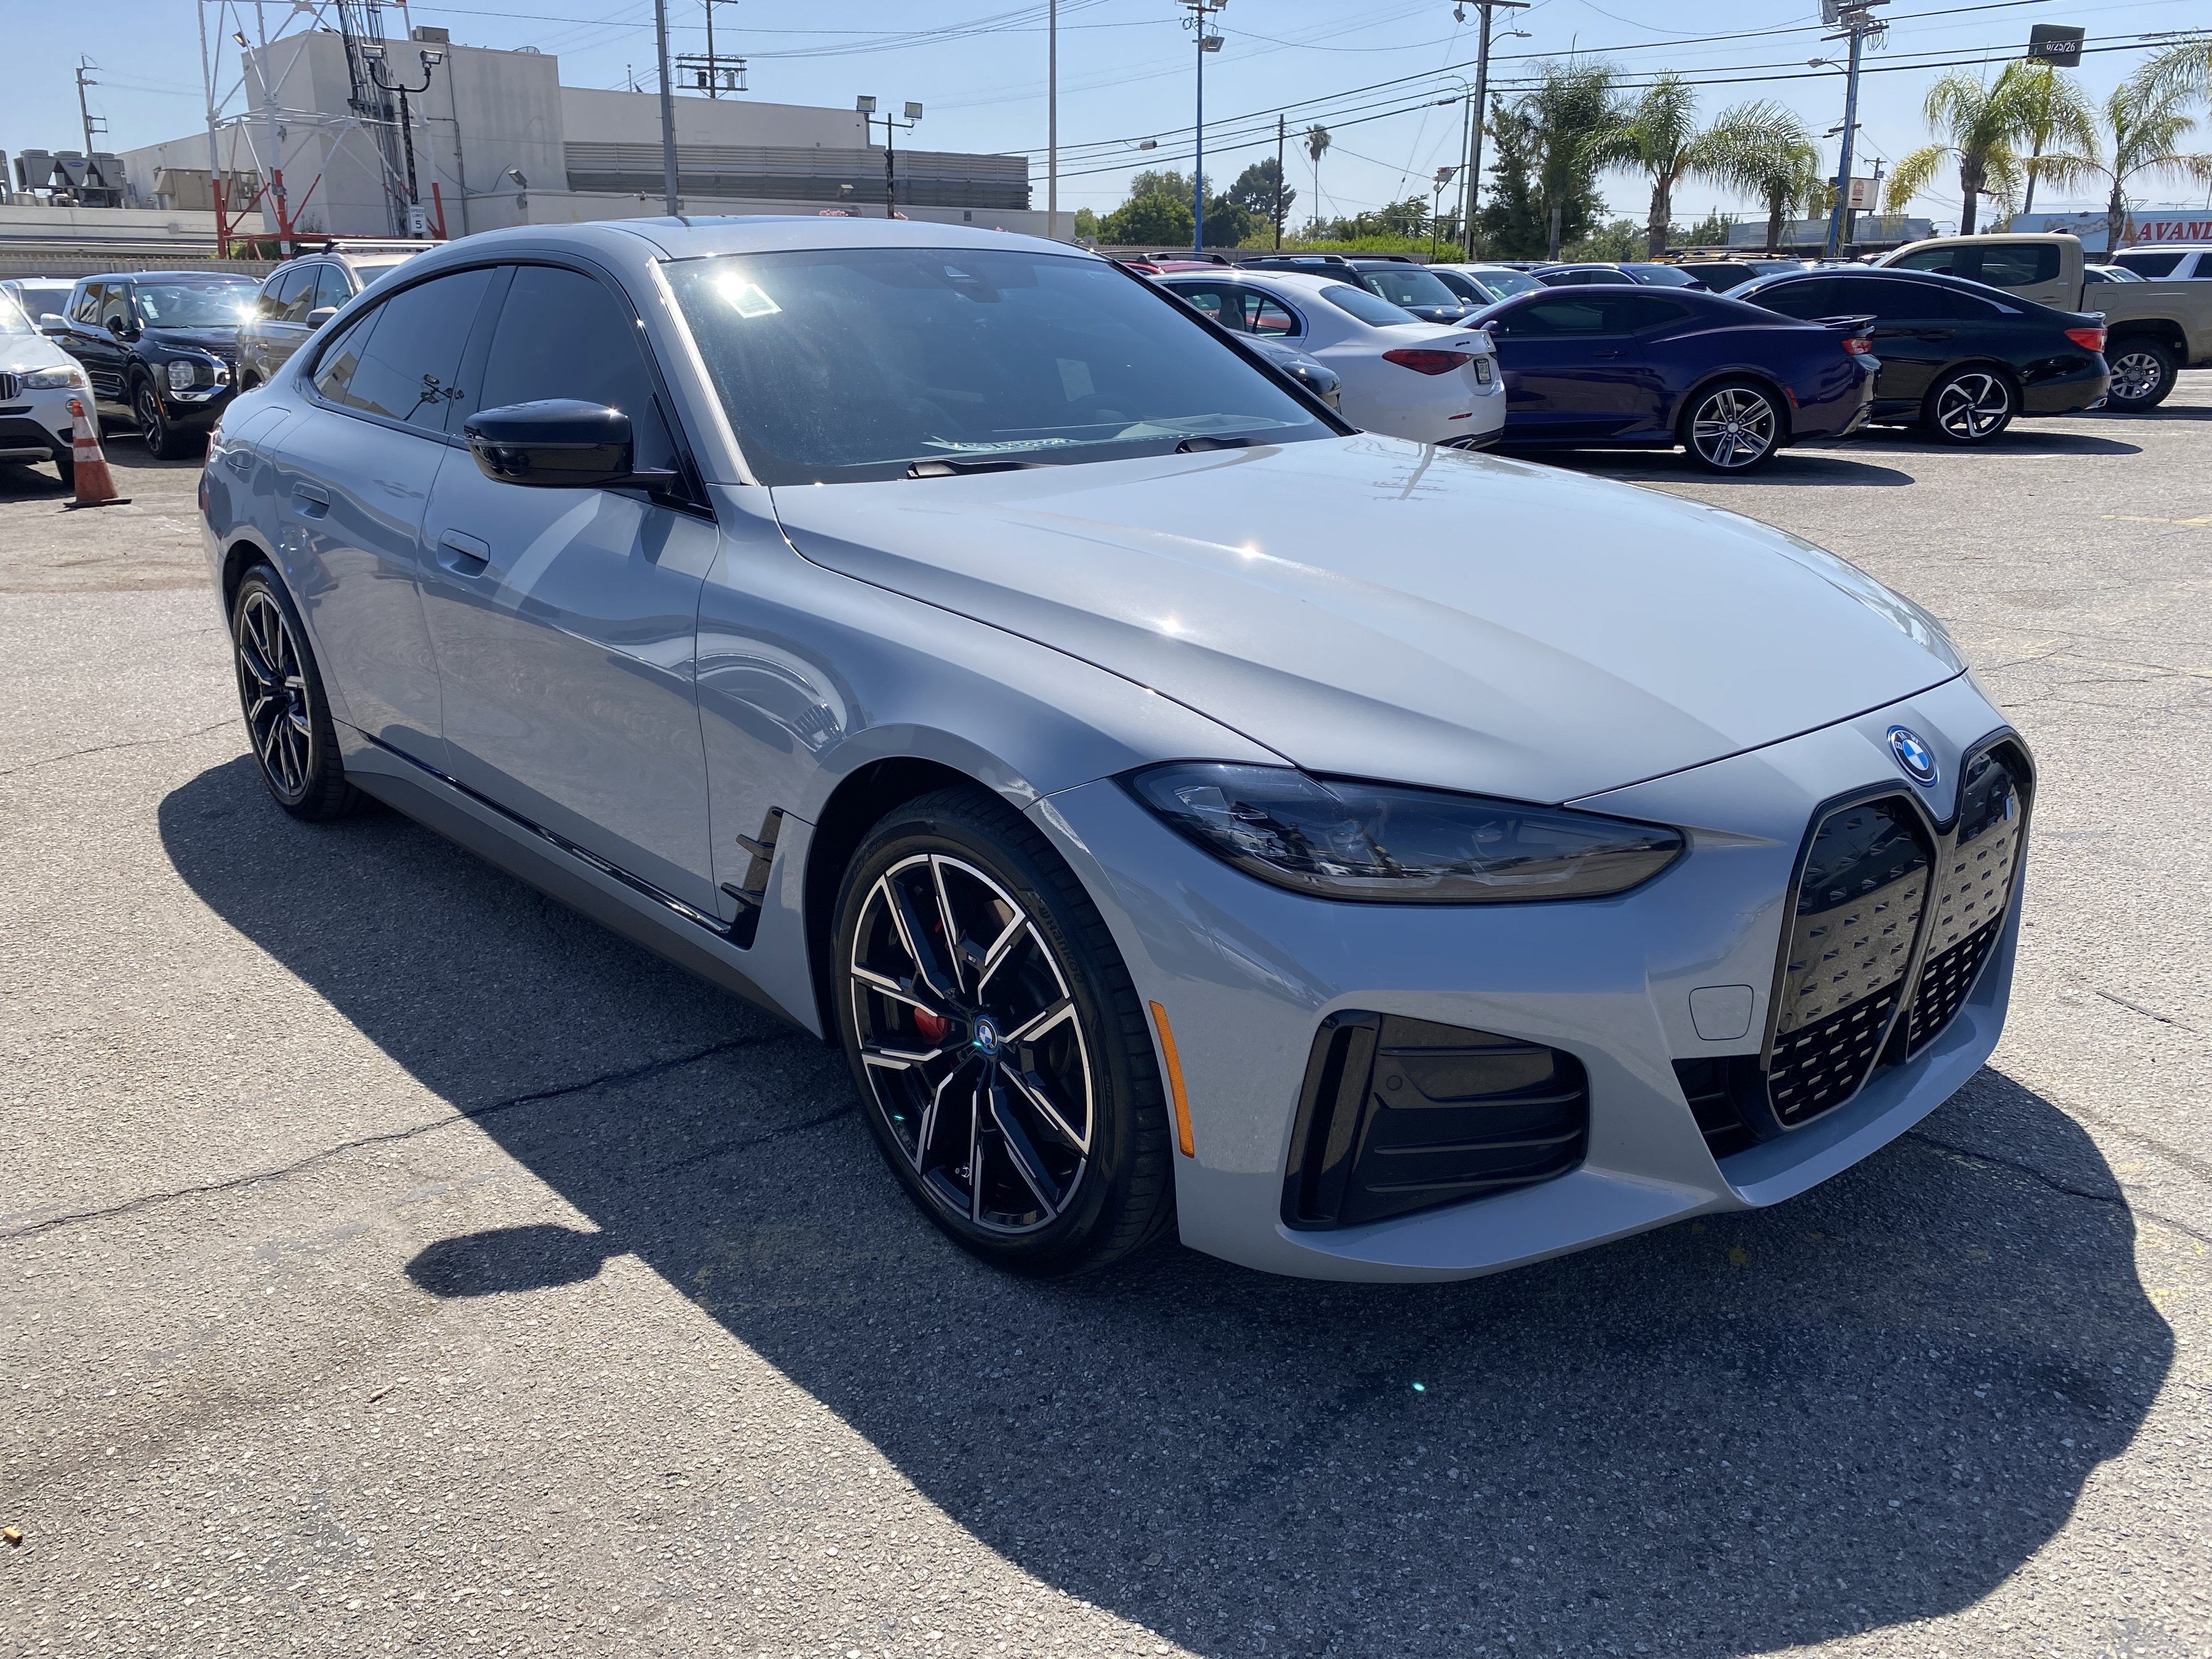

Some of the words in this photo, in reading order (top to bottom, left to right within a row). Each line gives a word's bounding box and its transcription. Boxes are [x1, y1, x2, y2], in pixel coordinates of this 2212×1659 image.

[2046, 41, 2075, 52] 6/25/26
[415, 220, 422, 228] 5
[1895, 732, 1918, 751] BMW
